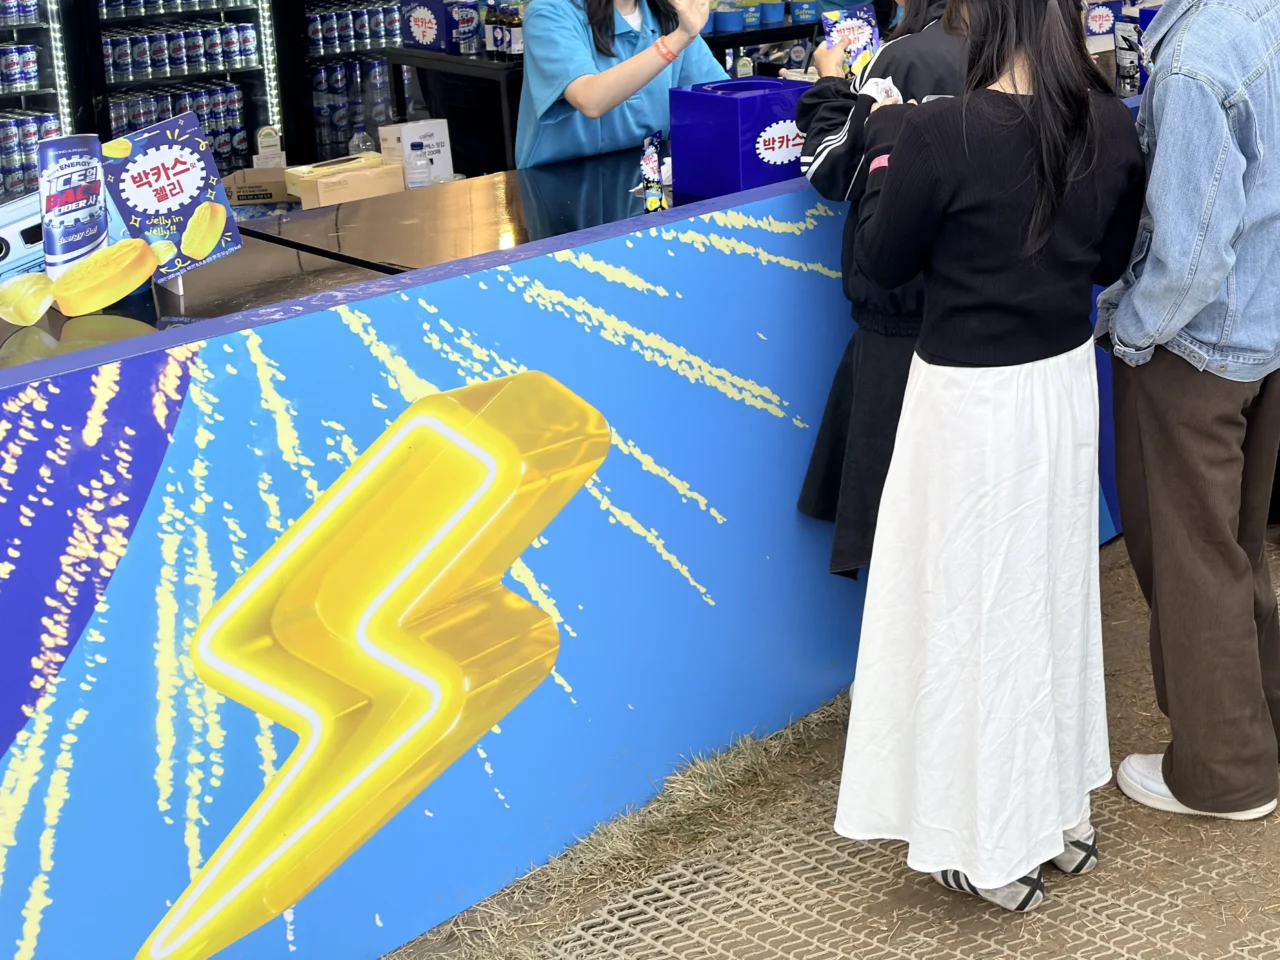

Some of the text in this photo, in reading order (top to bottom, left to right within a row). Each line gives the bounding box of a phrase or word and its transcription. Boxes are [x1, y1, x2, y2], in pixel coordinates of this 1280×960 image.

[413, 16, 434, 29] 박카스
[1090, 14, 1111, 23] 박카스
[763, 132, 805, 152] 박카스
[59, 160, 91, 171] ENERGY
[130, 157, 190, 188] 박카스
[47, 169, 86, 195] ICE
[152, 179, 184, 203] 젤리
[55, 199, 87, 216] CIDER
